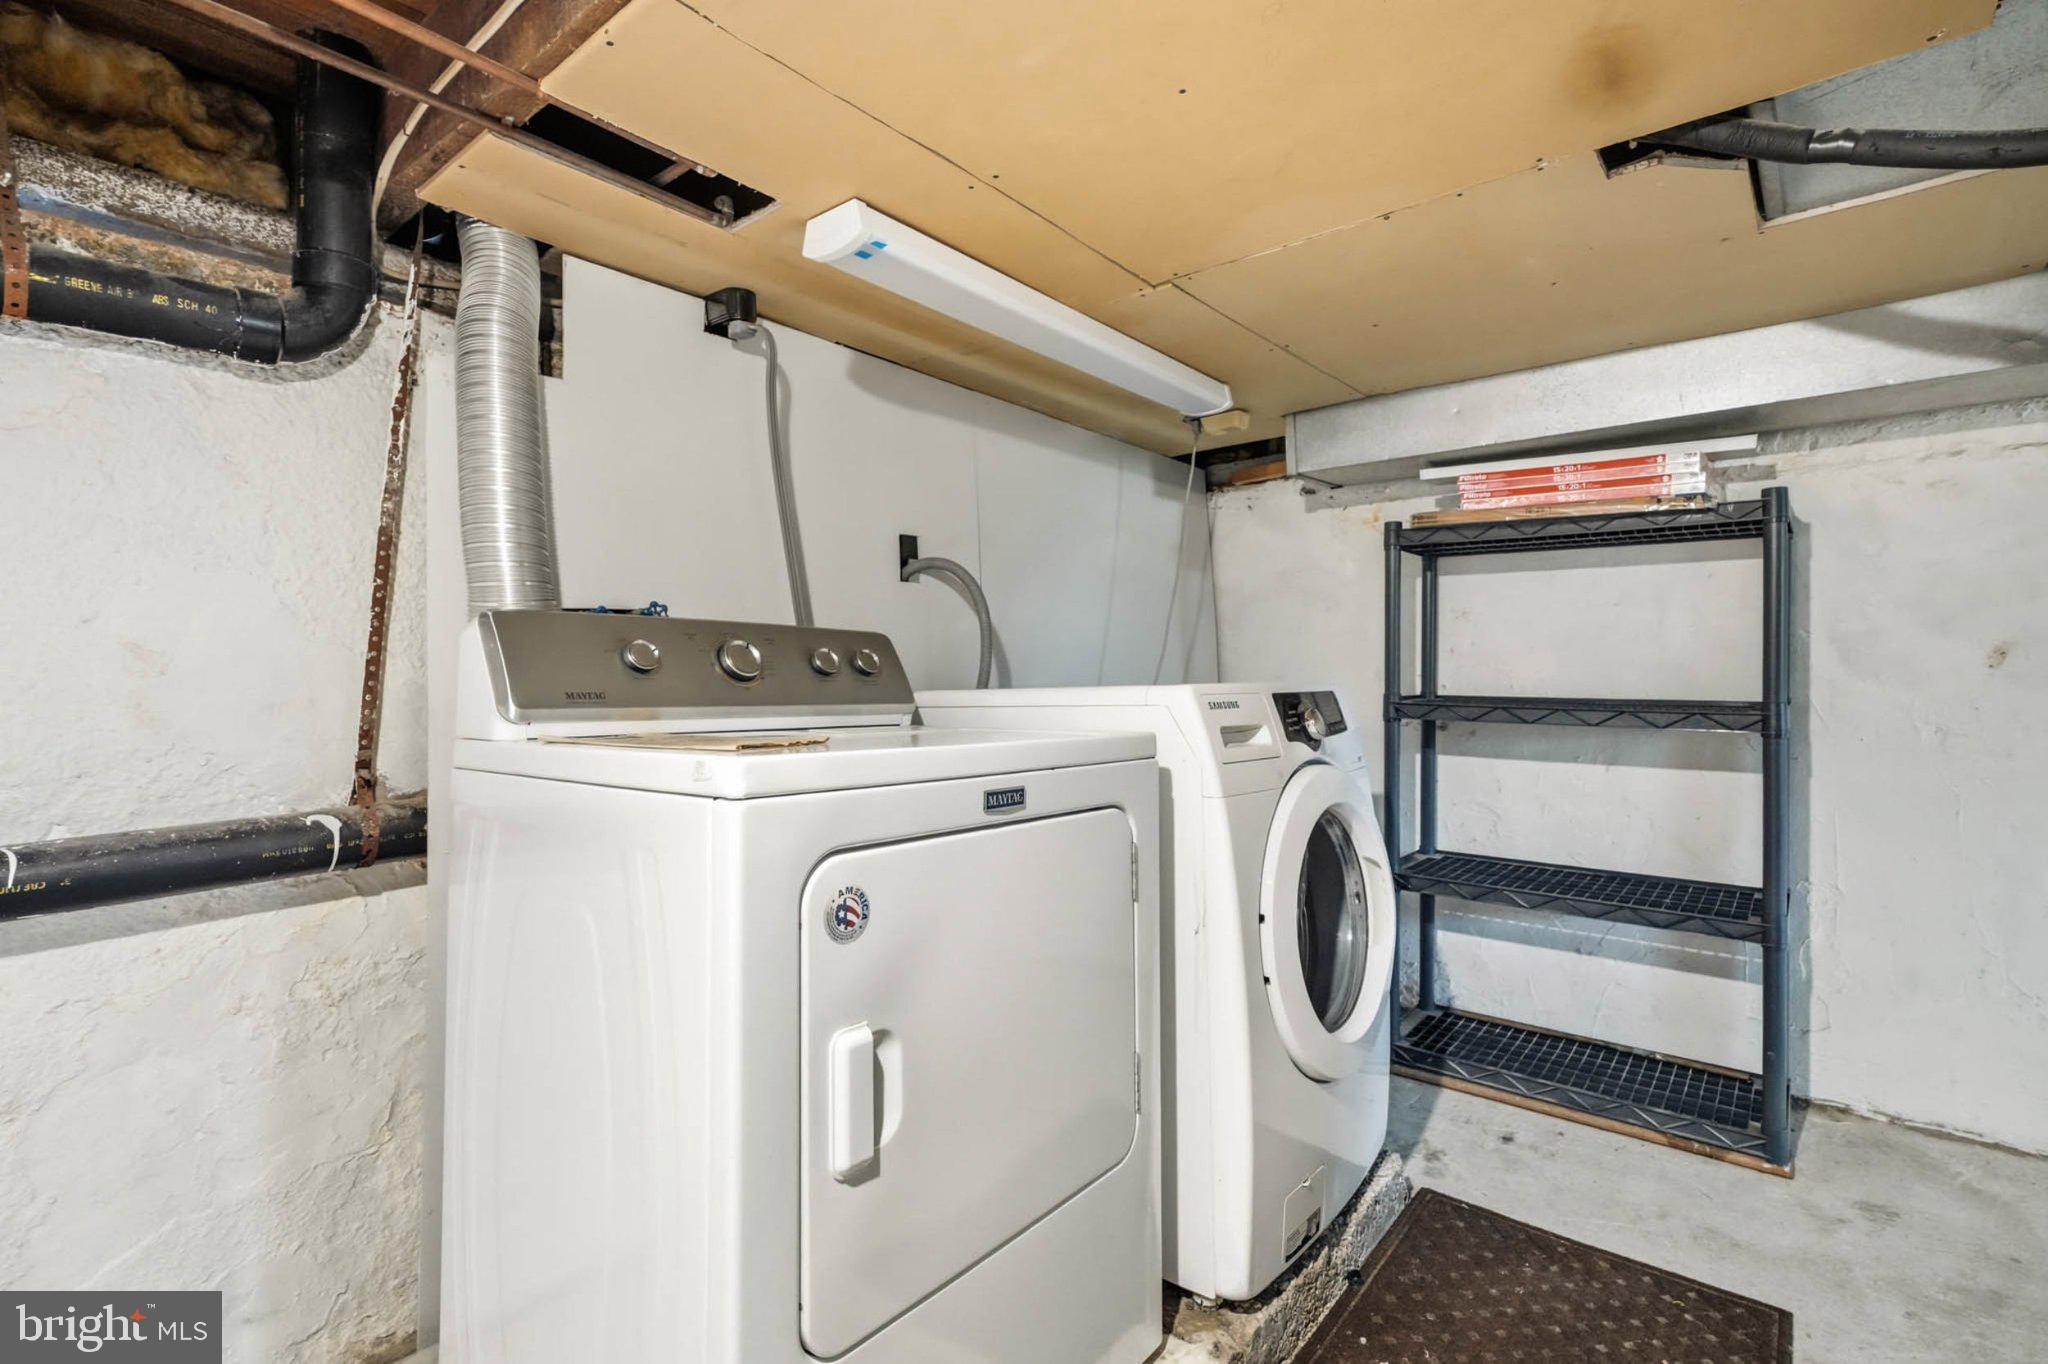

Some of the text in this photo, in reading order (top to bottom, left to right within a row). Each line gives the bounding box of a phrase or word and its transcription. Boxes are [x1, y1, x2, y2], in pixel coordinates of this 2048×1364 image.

[152, 294, 169, 307] ABS
[176, 298, 199, 311] SCH
[204, 305, 218, 315] 40
[565, 691, 606, 700] MAYTAG
[1208, 701, 1240, 710] SAMSUNG
[988, 791, 1024, 806] MAYTAG
[838, 886, 869, 920] AMERICA
